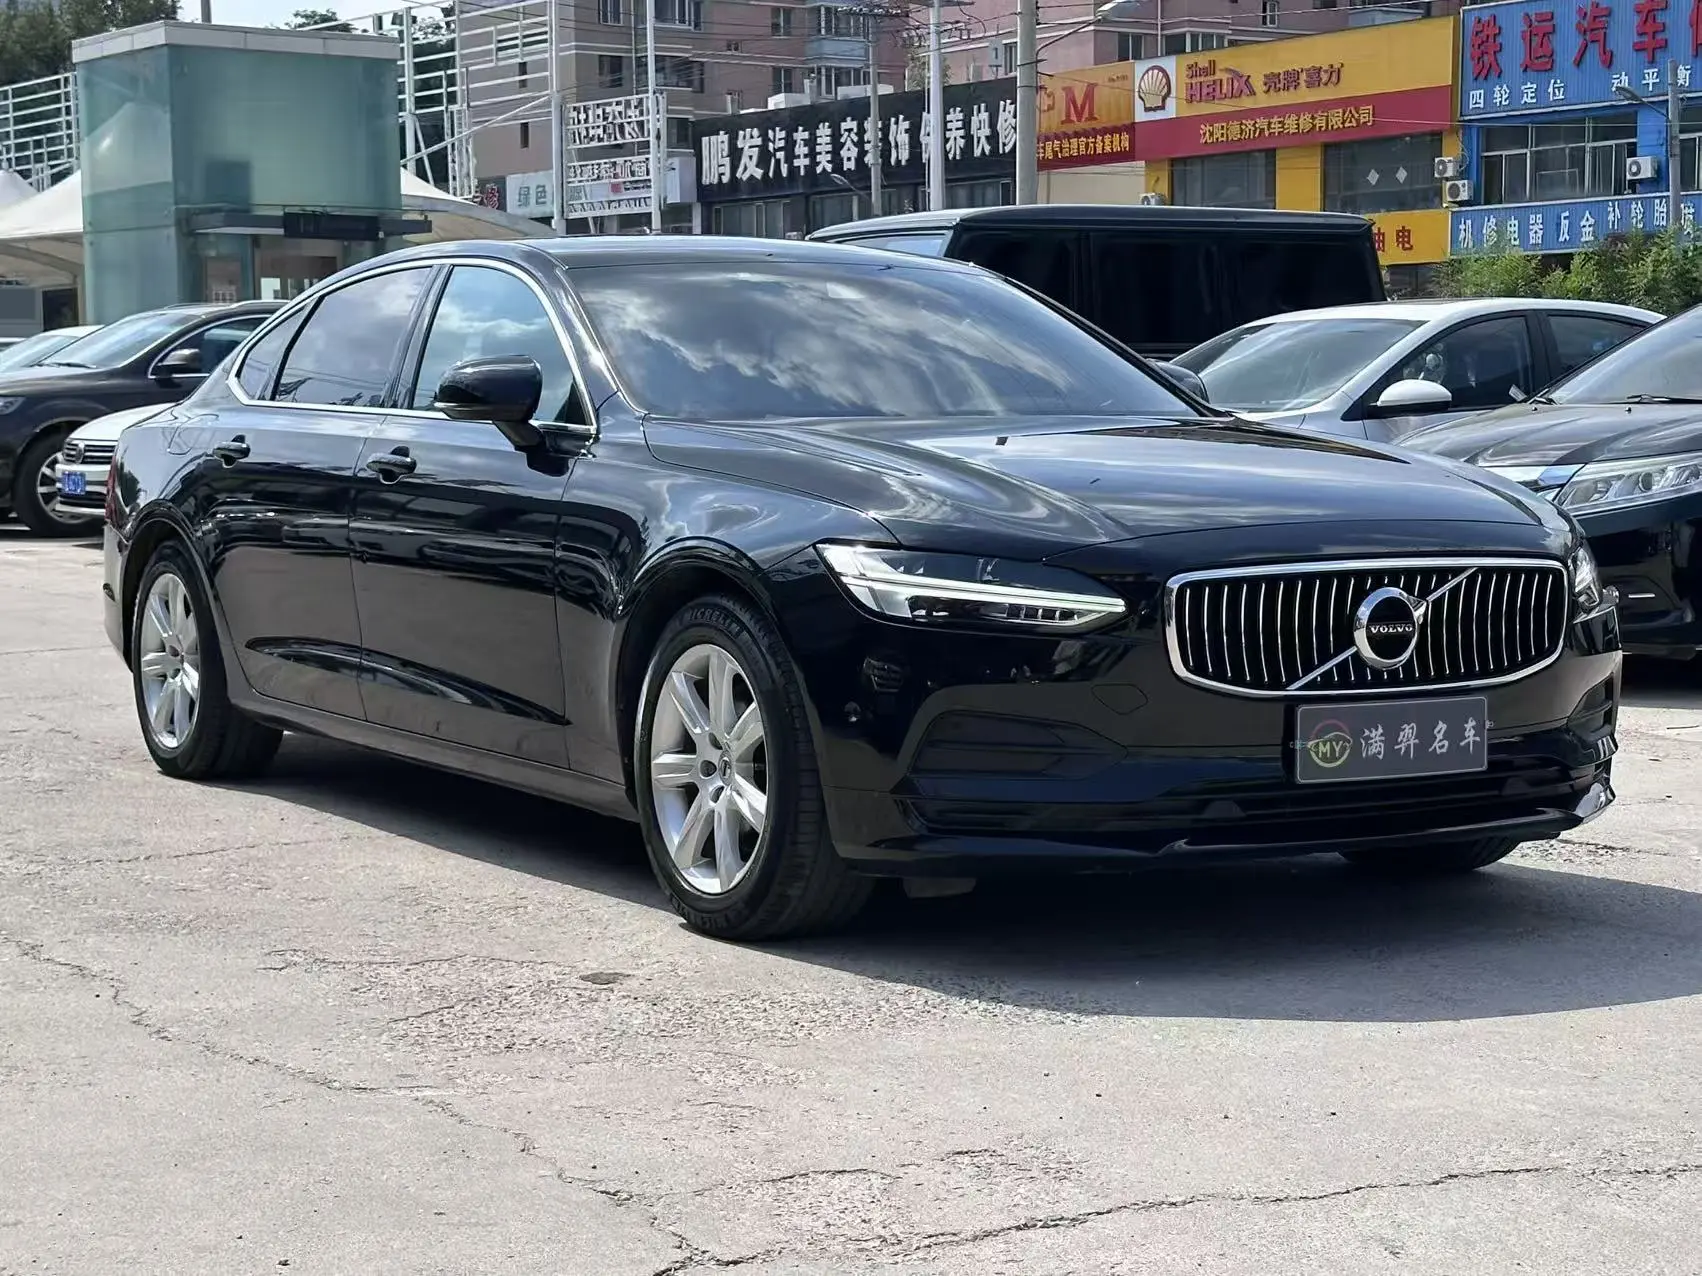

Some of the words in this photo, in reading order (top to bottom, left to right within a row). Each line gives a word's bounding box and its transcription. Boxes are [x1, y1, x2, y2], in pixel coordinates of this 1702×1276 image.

[1187, 60, 1216, 78] Shell
[1185, 74, 1255, 103] HELIX
[1469, 79, 1565, 109] 四轮定位
[1612, 64, 1691, 93] 动平衡
[1061, 83, 1099, 125] M
[1200, 104, 1374, 144] 沈阳德济汽车维修有限公司
[1370, 623, 1413, 634] VOLVO
